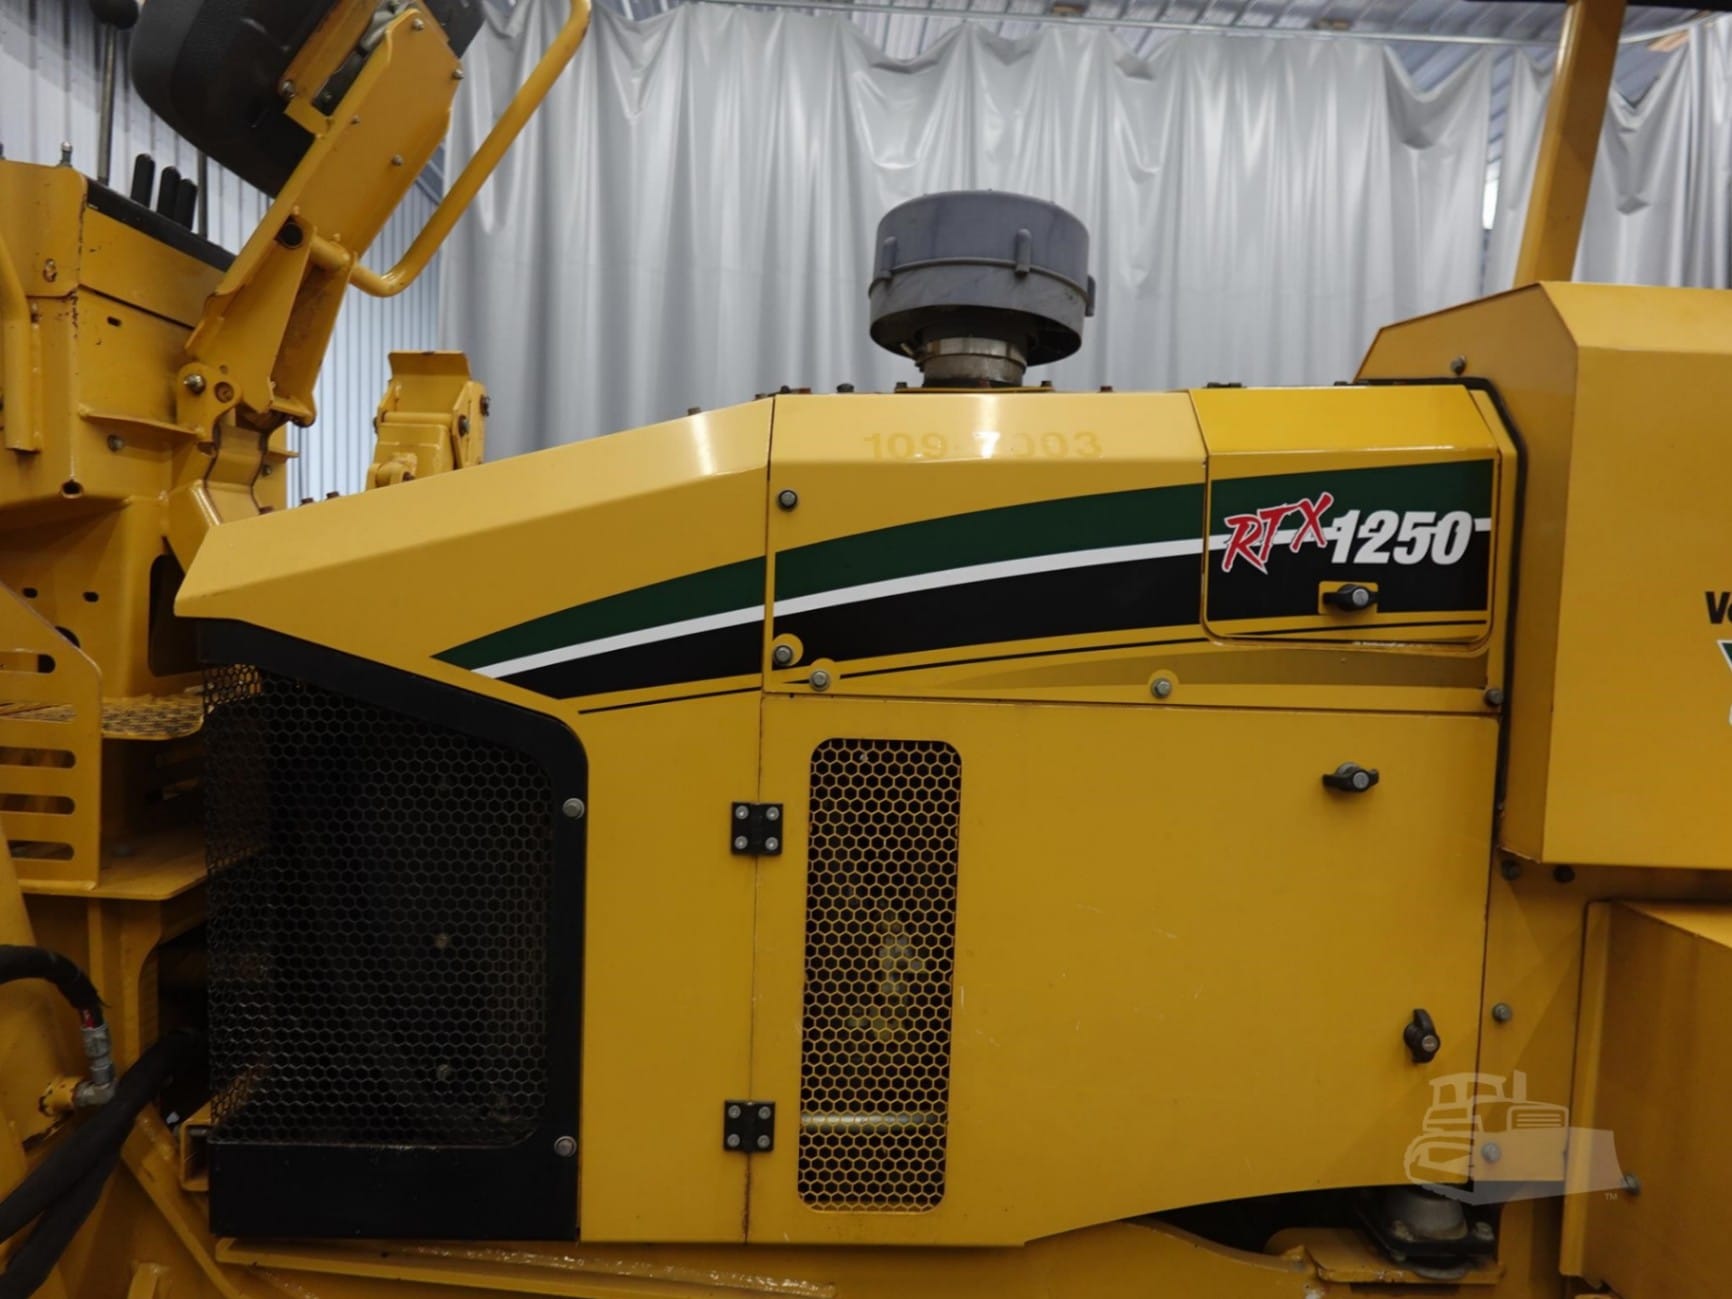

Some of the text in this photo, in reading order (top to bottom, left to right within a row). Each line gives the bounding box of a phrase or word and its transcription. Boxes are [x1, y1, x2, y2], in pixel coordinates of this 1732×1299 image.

[863, 432, 948, 463] 109
[1220, 491, 1472, 575] RTX 1250
